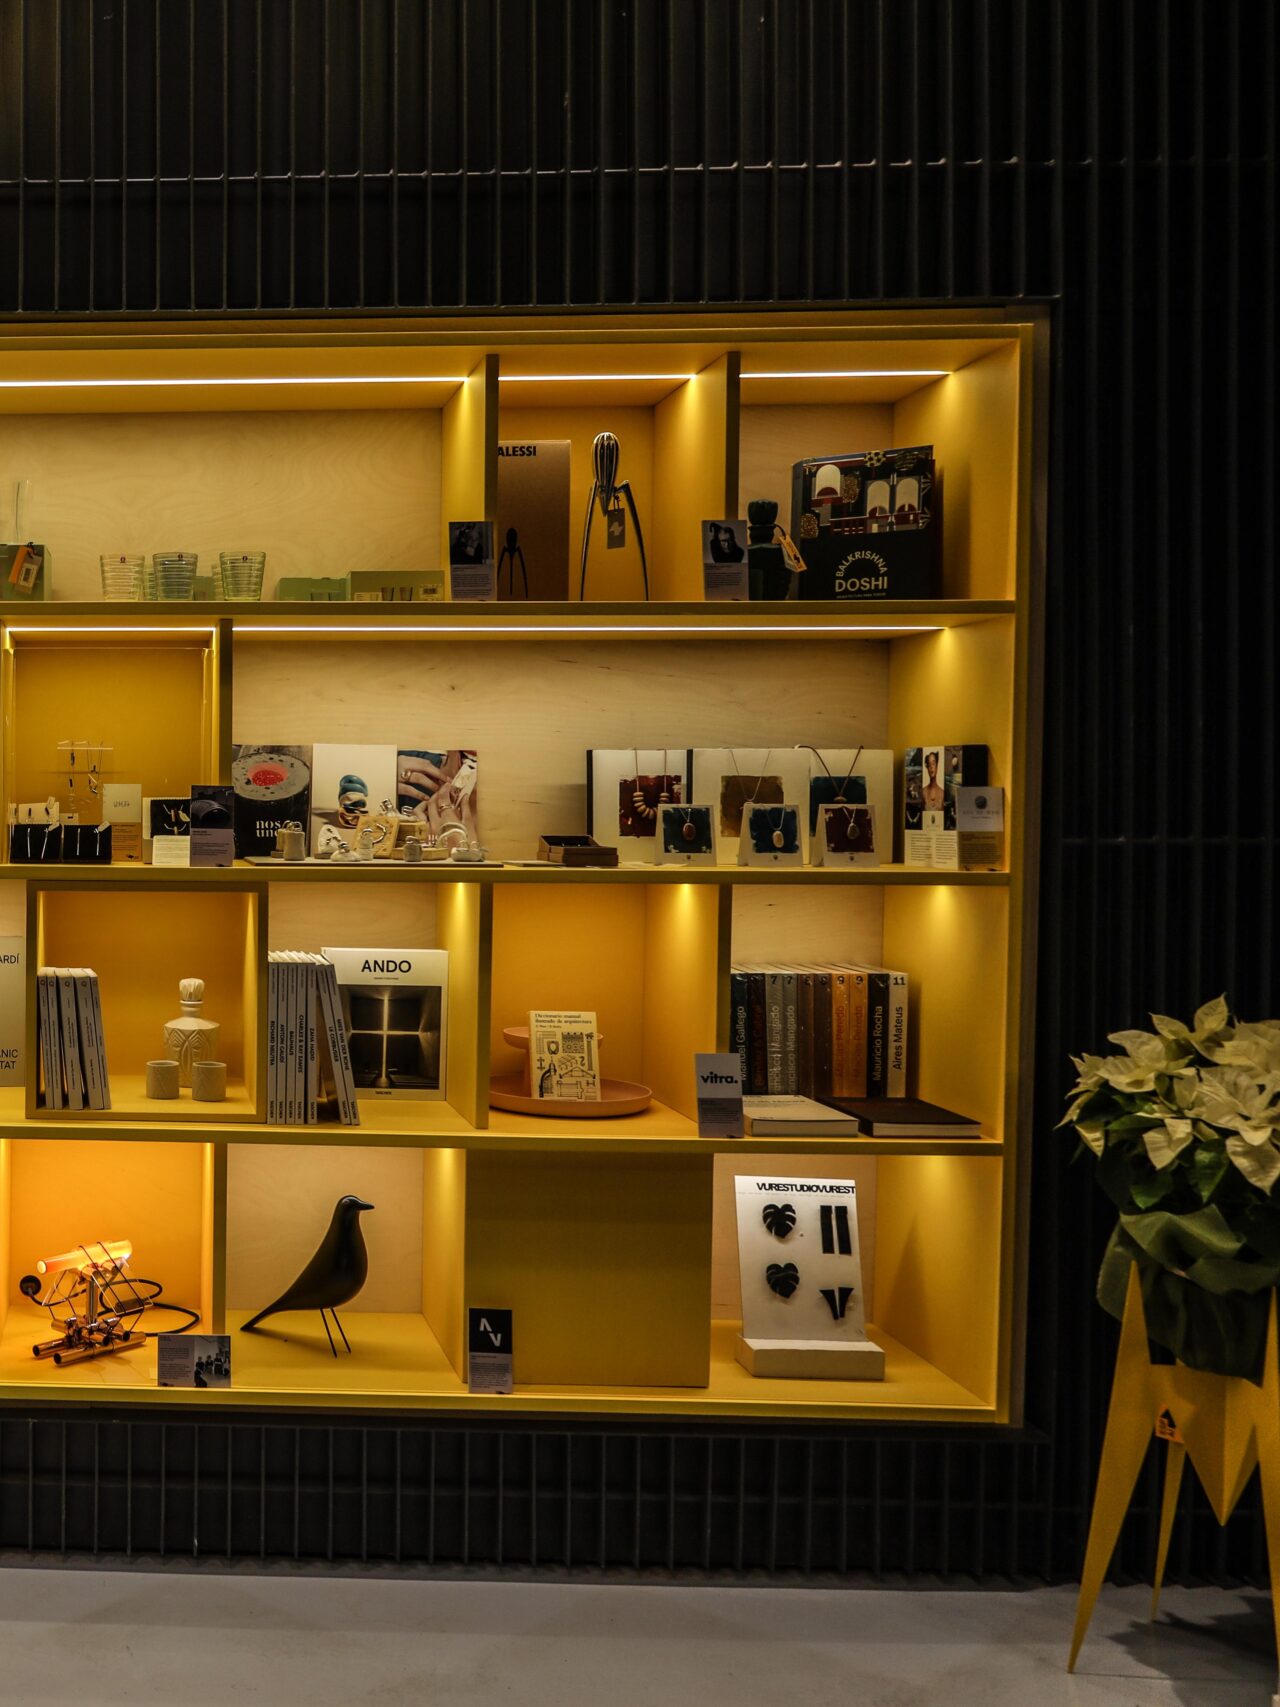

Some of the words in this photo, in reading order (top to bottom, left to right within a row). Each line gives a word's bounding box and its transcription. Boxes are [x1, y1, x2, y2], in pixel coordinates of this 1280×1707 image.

[497, 446, 537, 457] ALESSI
[835, 550, 888, 577] BALKRISHNA
[835, 576, 888, 592] DOSHI
[256, 820, 281, 829] nos
[361, 959, 412, 974] ANDO
[771, 976, 777, 984] 7
[786, 976, 793, 984] 7
[893, 976, 906, 985] 11
[736, 1005, 746, 1042] Gallego
[771, 1005, 782, 1051] Mangado
[786, 1005, 798, 1051] Mangado
[873, 1006, 882, 1036] Rocha
[893, 1007, 903, 1042] Mateus
[329, 1033, 339, 1062] CORBUSIER
[893, 1044, 902, 1070] Aires
[342, 1056, 350, 1071] ROHE
[873, 1039, 882, 1080] Mauricio
[700, 1071, 738, 1084] vitra.
